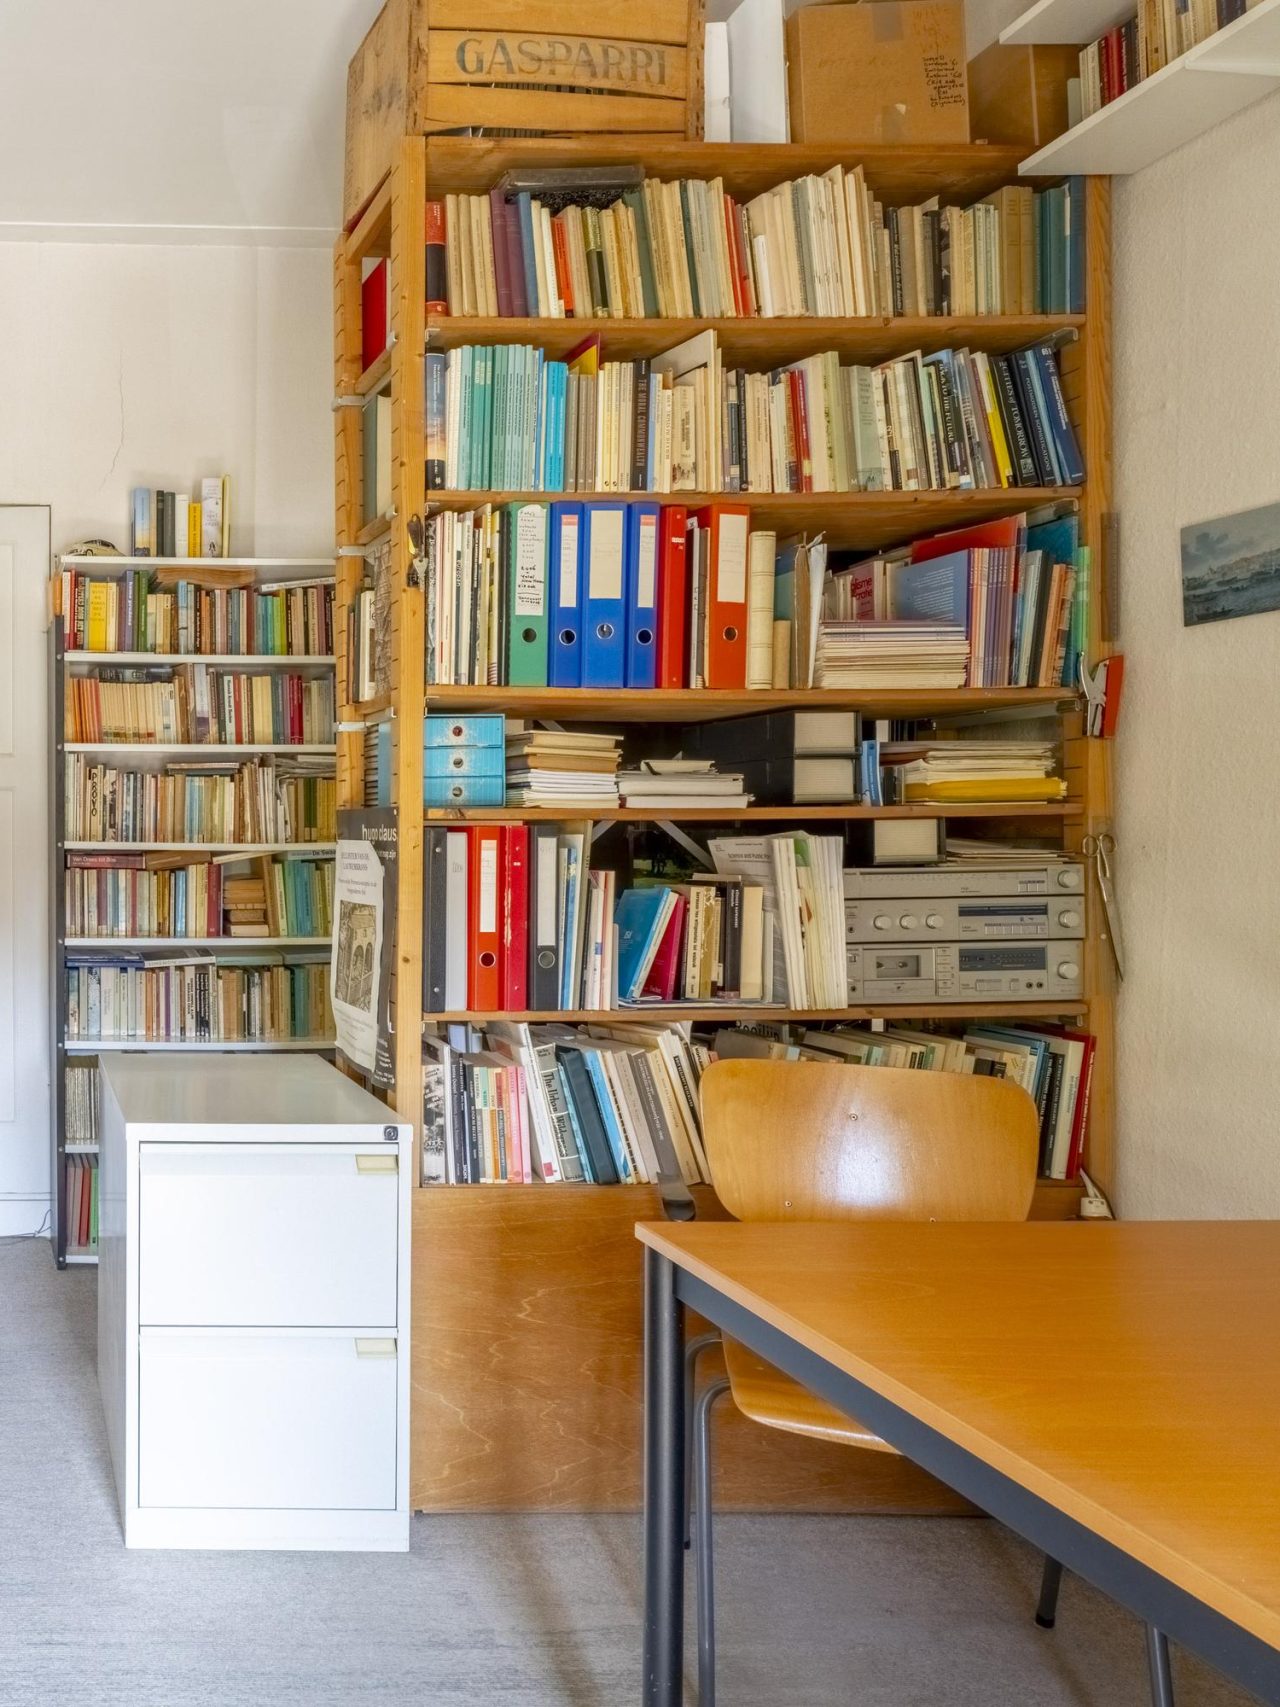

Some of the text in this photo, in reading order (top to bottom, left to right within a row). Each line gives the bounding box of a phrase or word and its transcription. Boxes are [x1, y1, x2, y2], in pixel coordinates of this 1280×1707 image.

[455, 37, 667, 86] GASPARRI
[635, 379, 647, 467] THE MORAL COMMONWEALTH
[944, 412, 955, 443] FUTURE
[1001, 366, 1014, 397] CITIES
[1009, 407, 1031, 458] TOMORROW
[1025, 377, 1051, 471] POSTMODERN SOPHISTICATIONS
[361, 823, 397, 845] hugo claus
[543, 1072, 559, 1112] The Urban
